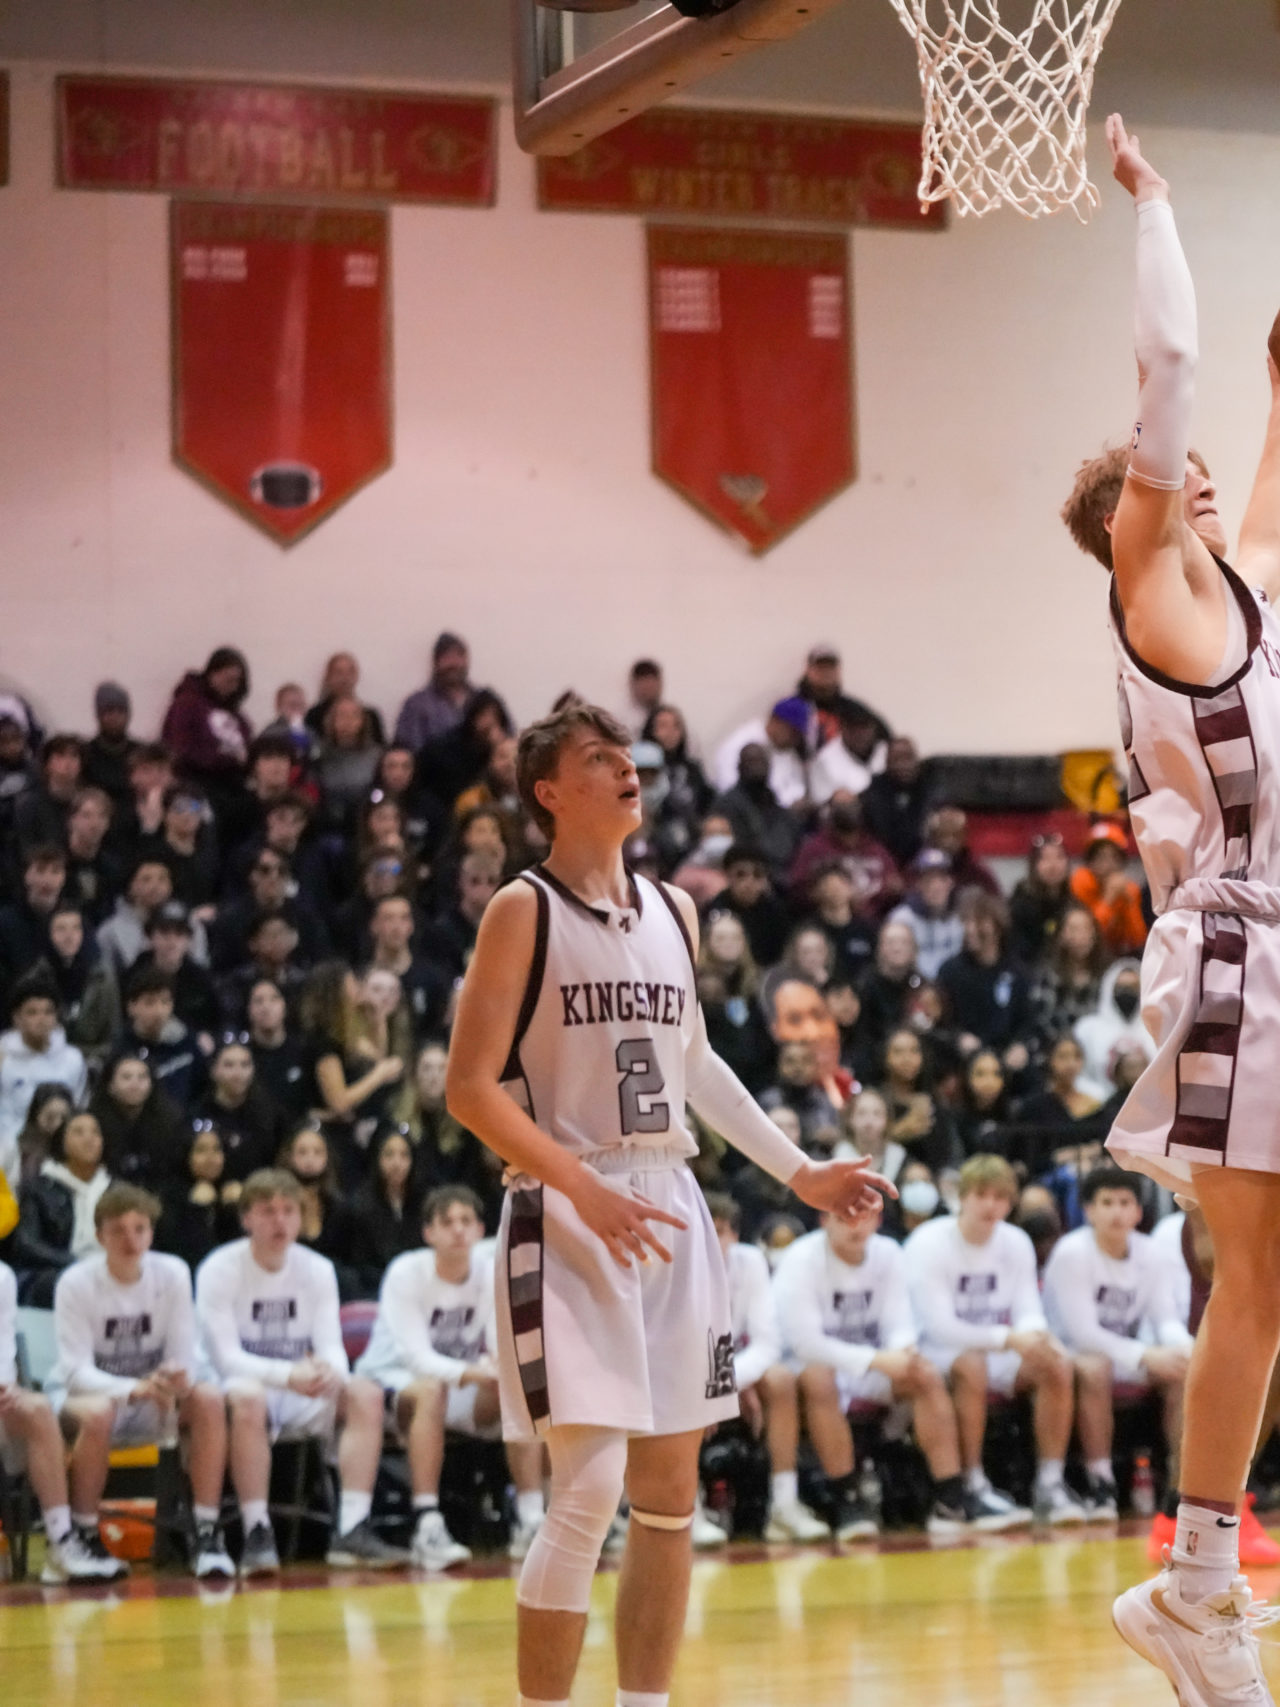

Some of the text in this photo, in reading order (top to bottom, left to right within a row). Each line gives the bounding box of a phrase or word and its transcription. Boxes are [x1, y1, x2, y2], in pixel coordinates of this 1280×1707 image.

[158, 118, 398, 190] FOOTBALL
[560, 981, 686, 1027] KINGSMEN
[615, 1037, 670, 1136] 2
